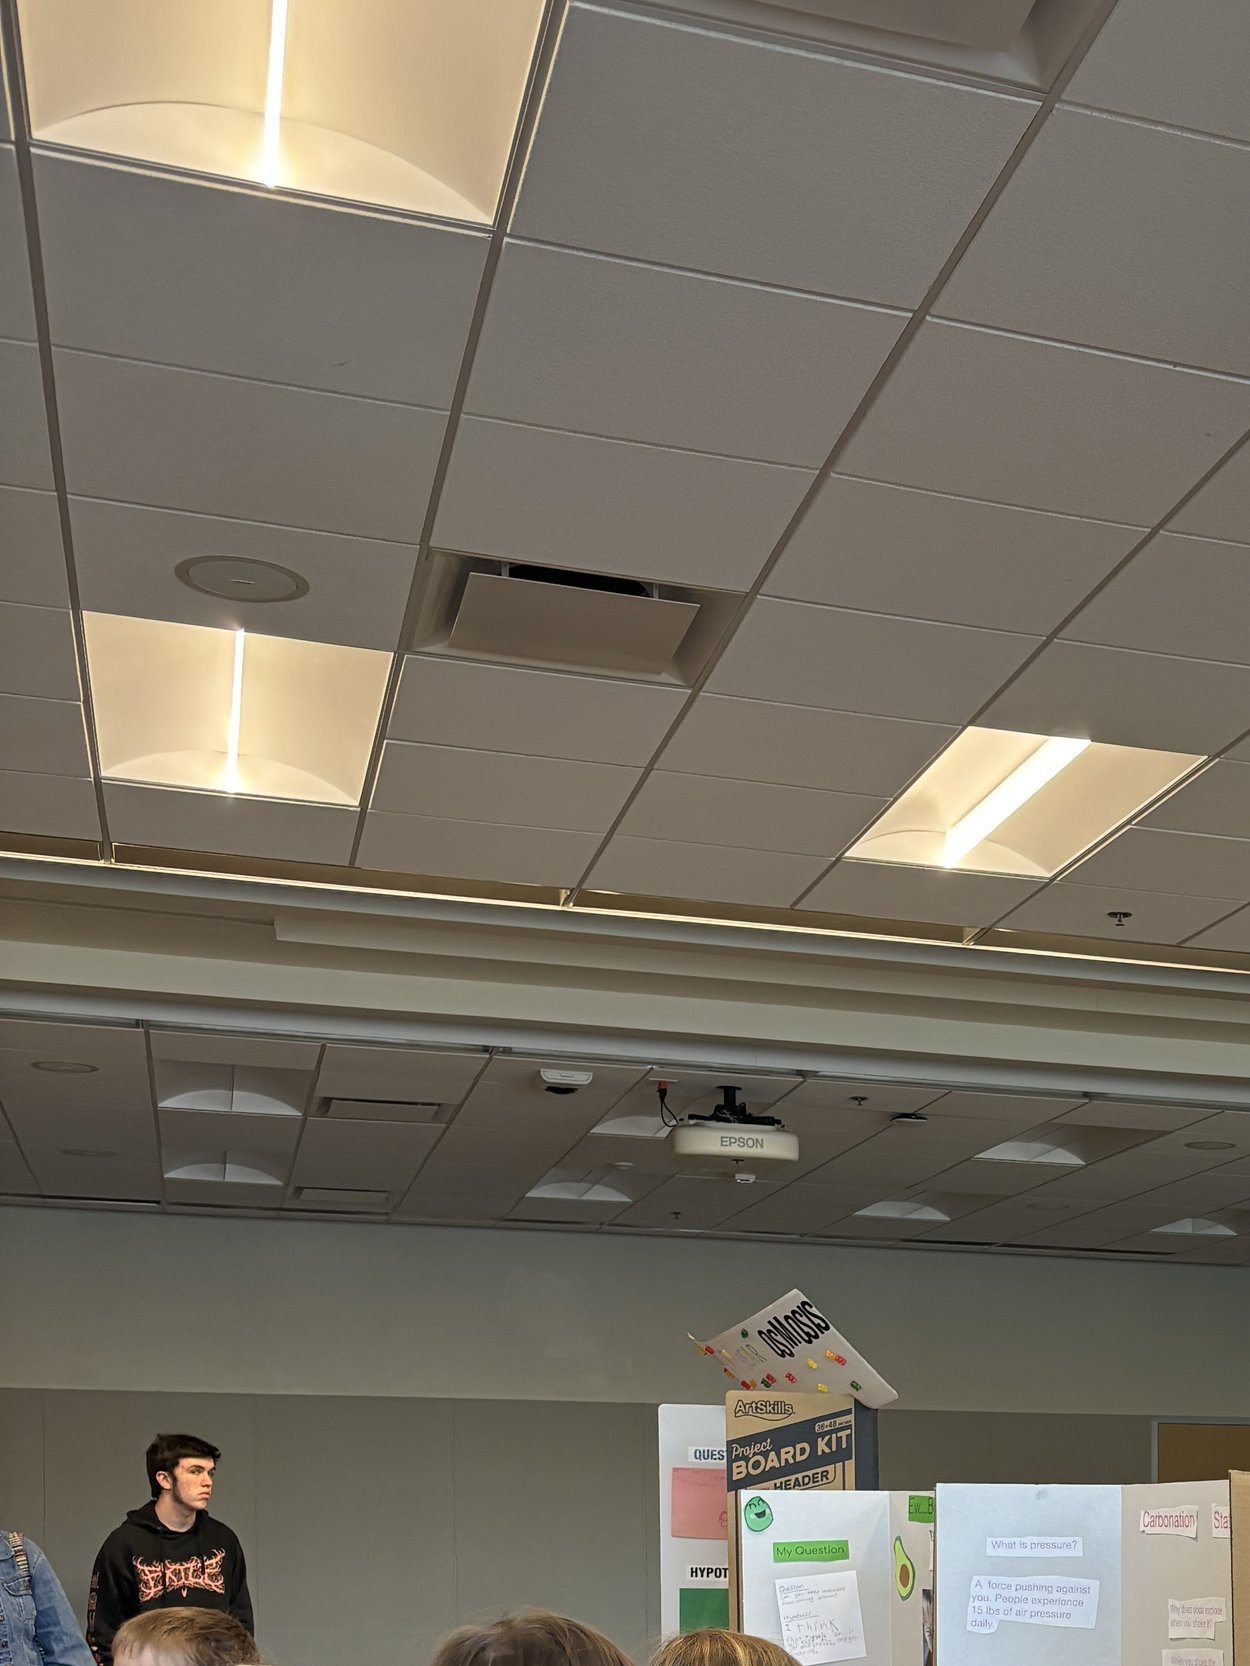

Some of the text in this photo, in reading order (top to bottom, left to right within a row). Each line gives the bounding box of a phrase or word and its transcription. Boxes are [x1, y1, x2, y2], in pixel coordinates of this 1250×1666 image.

[720, 1136, 764, 1149] EPSON
[694, 1449, 726, 1460] QUES
[731, 1438, 772, 1459] Project
[733, 1430, 851, 1480] BOARD KIT
[774, 1470, 829, 1490] HEADER
[1143, 1511, 1194, 1528] Carbonation
[776, 1544, 845, 1557] My Question
[992, 1540, 1077, 1550] What is pressure?
[975, 1580, 1090, 1595] A force pushing against
[972, 1594, 1083, 1608] you. People experience
[972, 1606, 1071, 1619] 15 lbs of air pressure
[970, 1619, 994, 1629] daily.
